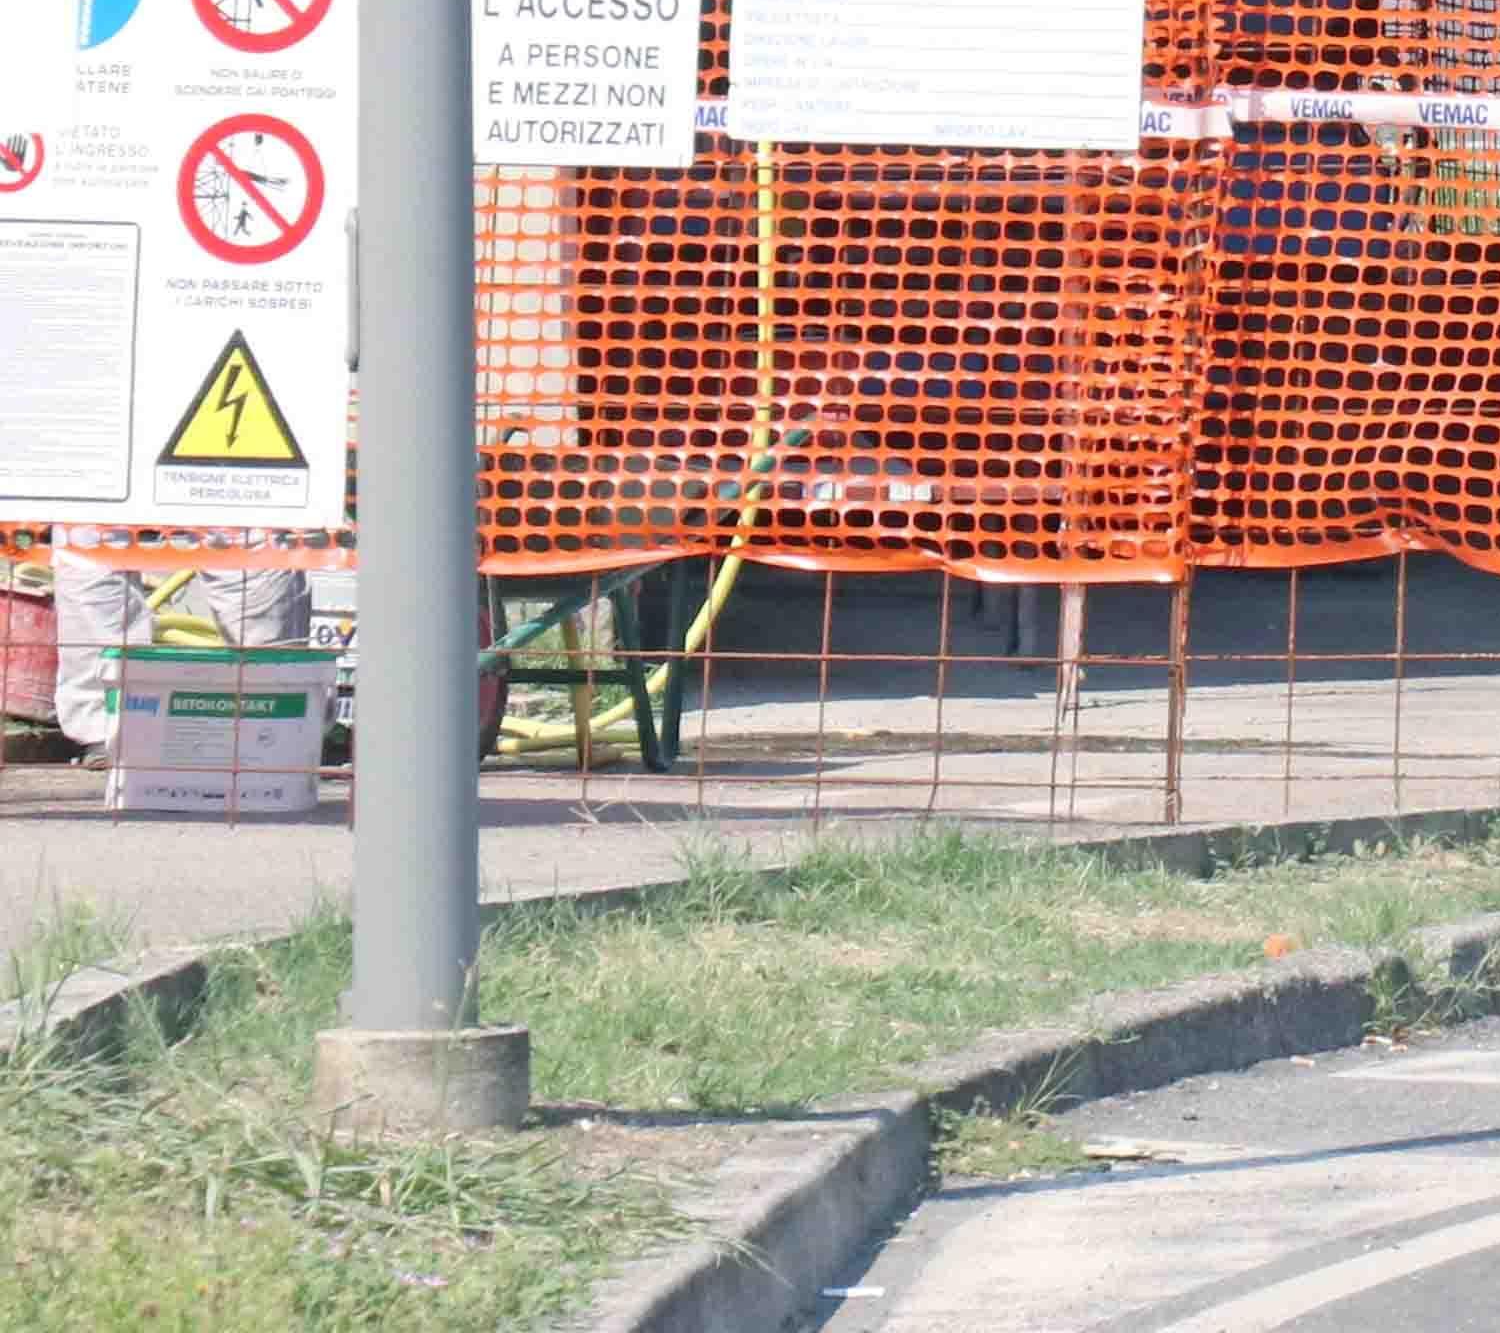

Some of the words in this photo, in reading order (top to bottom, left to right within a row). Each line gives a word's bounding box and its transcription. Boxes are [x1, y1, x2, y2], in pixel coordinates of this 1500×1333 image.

[498, 42, 515, 67] A
[527, 43, 661, 70] PERSONE
[210, 68, 240, 79] NON
[487, 80, 503, 105] E
[513, 81, 597, 107] MEZZI
[607, 84, 666, 108] NON
[1290, 98, 1353, 120] VEMAC
[1418, 102, 1489, 126] VEMAC
[486, 119, 665, 147] AUTORIZZATI
[166, 277, 197, 292] NON
[202, 278, 270, 293] PASSARE
[274, 280, 323, 295] SOTTO
[162, 470, 228, 485] TENSIONE
[230, 473, 301, 488] ELETTRICA
[188, 486, 272, 502] PERICOLOSA
